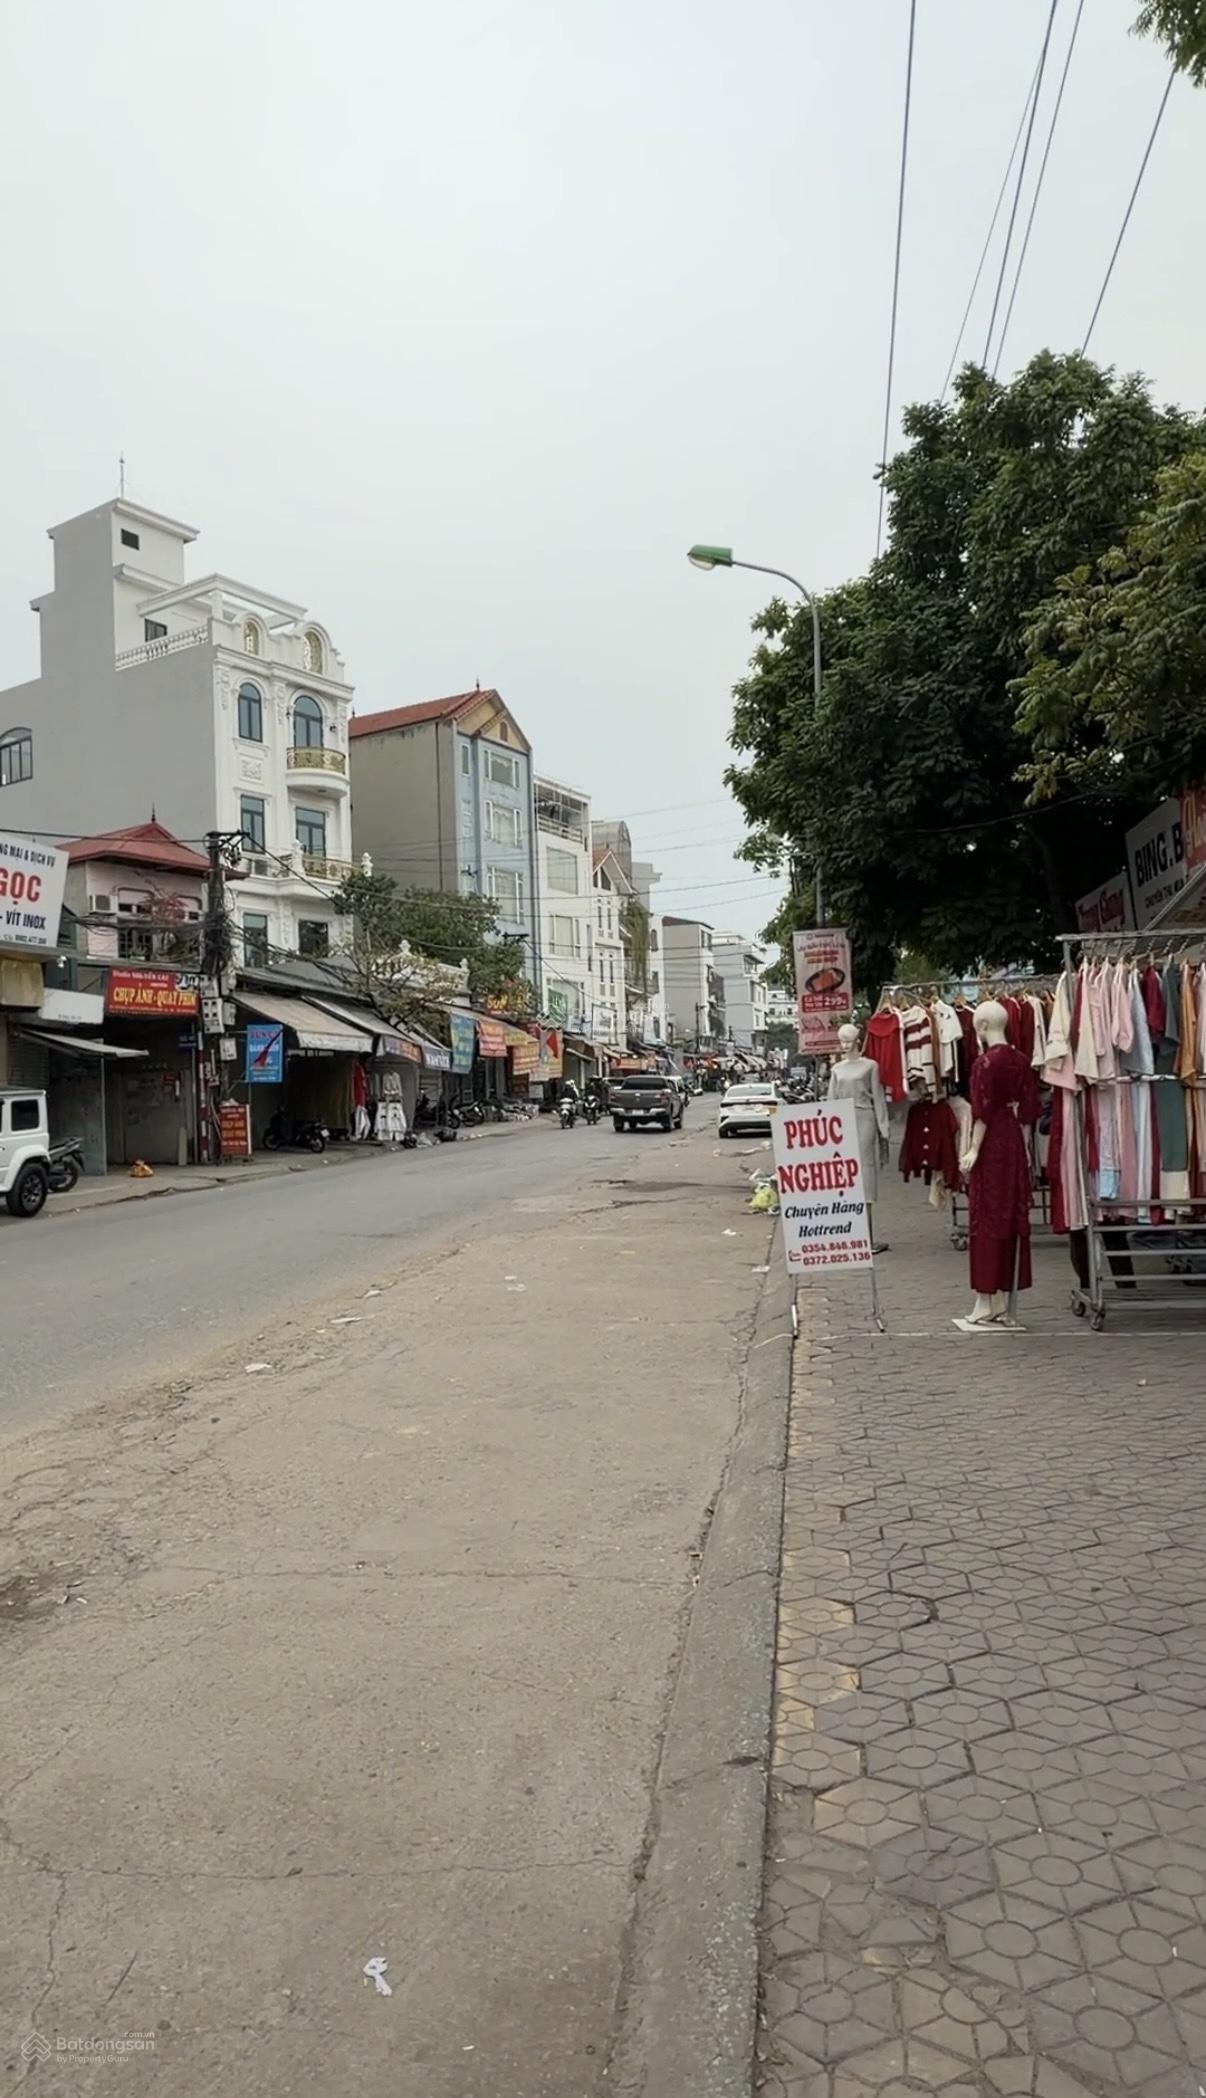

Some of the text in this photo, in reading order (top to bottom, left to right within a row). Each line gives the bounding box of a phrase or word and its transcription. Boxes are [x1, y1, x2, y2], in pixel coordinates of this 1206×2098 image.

[6, 908, 21, 926] VÍT
[23, 912, 46, 930] INOX
[784, 1109, 843, 1149] PHÚC
[777, 1151, 859, 1197] NGHIỆP
[785, 1203, 829, 1220] Chuyên
[799, 1222, 852, 1238] Hottrend
